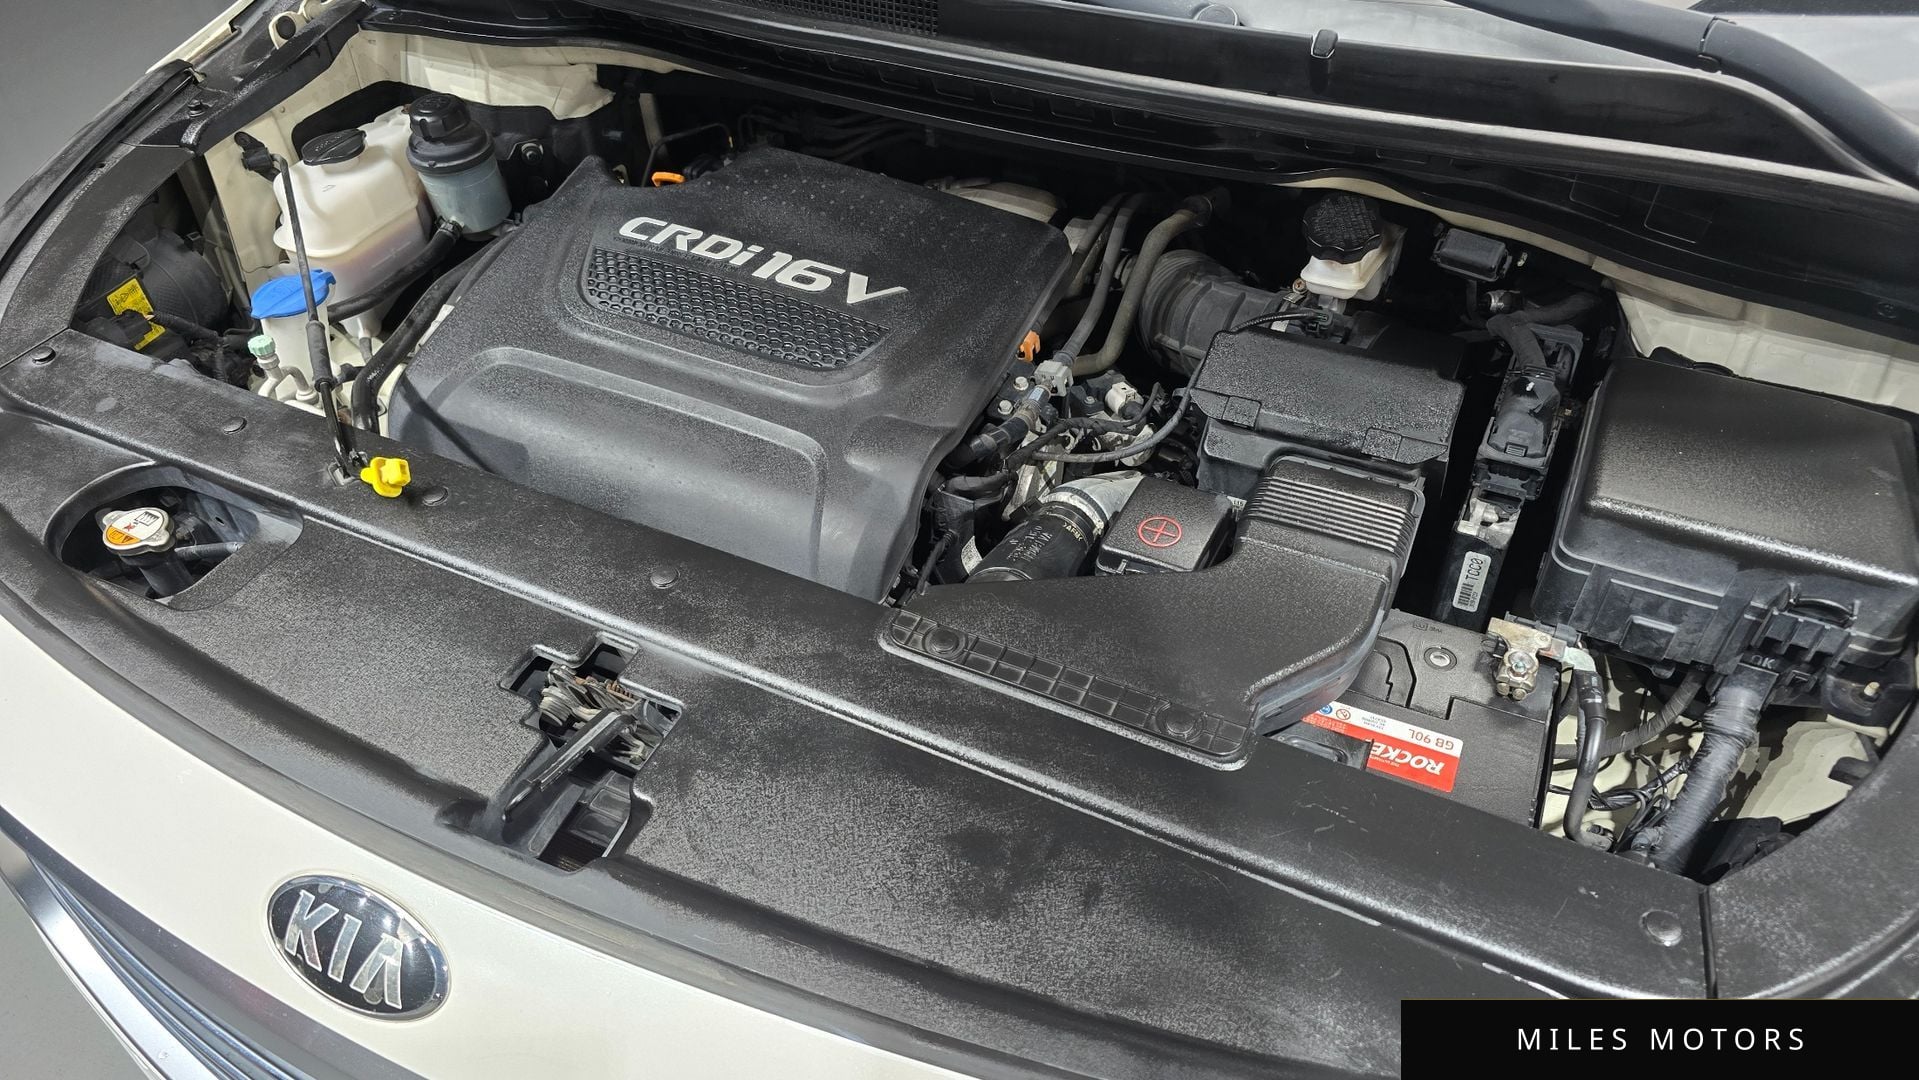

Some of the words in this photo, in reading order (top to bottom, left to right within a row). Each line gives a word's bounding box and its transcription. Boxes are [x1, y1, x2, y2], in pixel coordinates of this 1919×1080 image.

[1408, 728, 1431, 744] 90L
[1435, 737, 1455, 751] GB
[1365, 738, 1446, 776] ROCKE
[284, 889, 403, 1010] KIA
